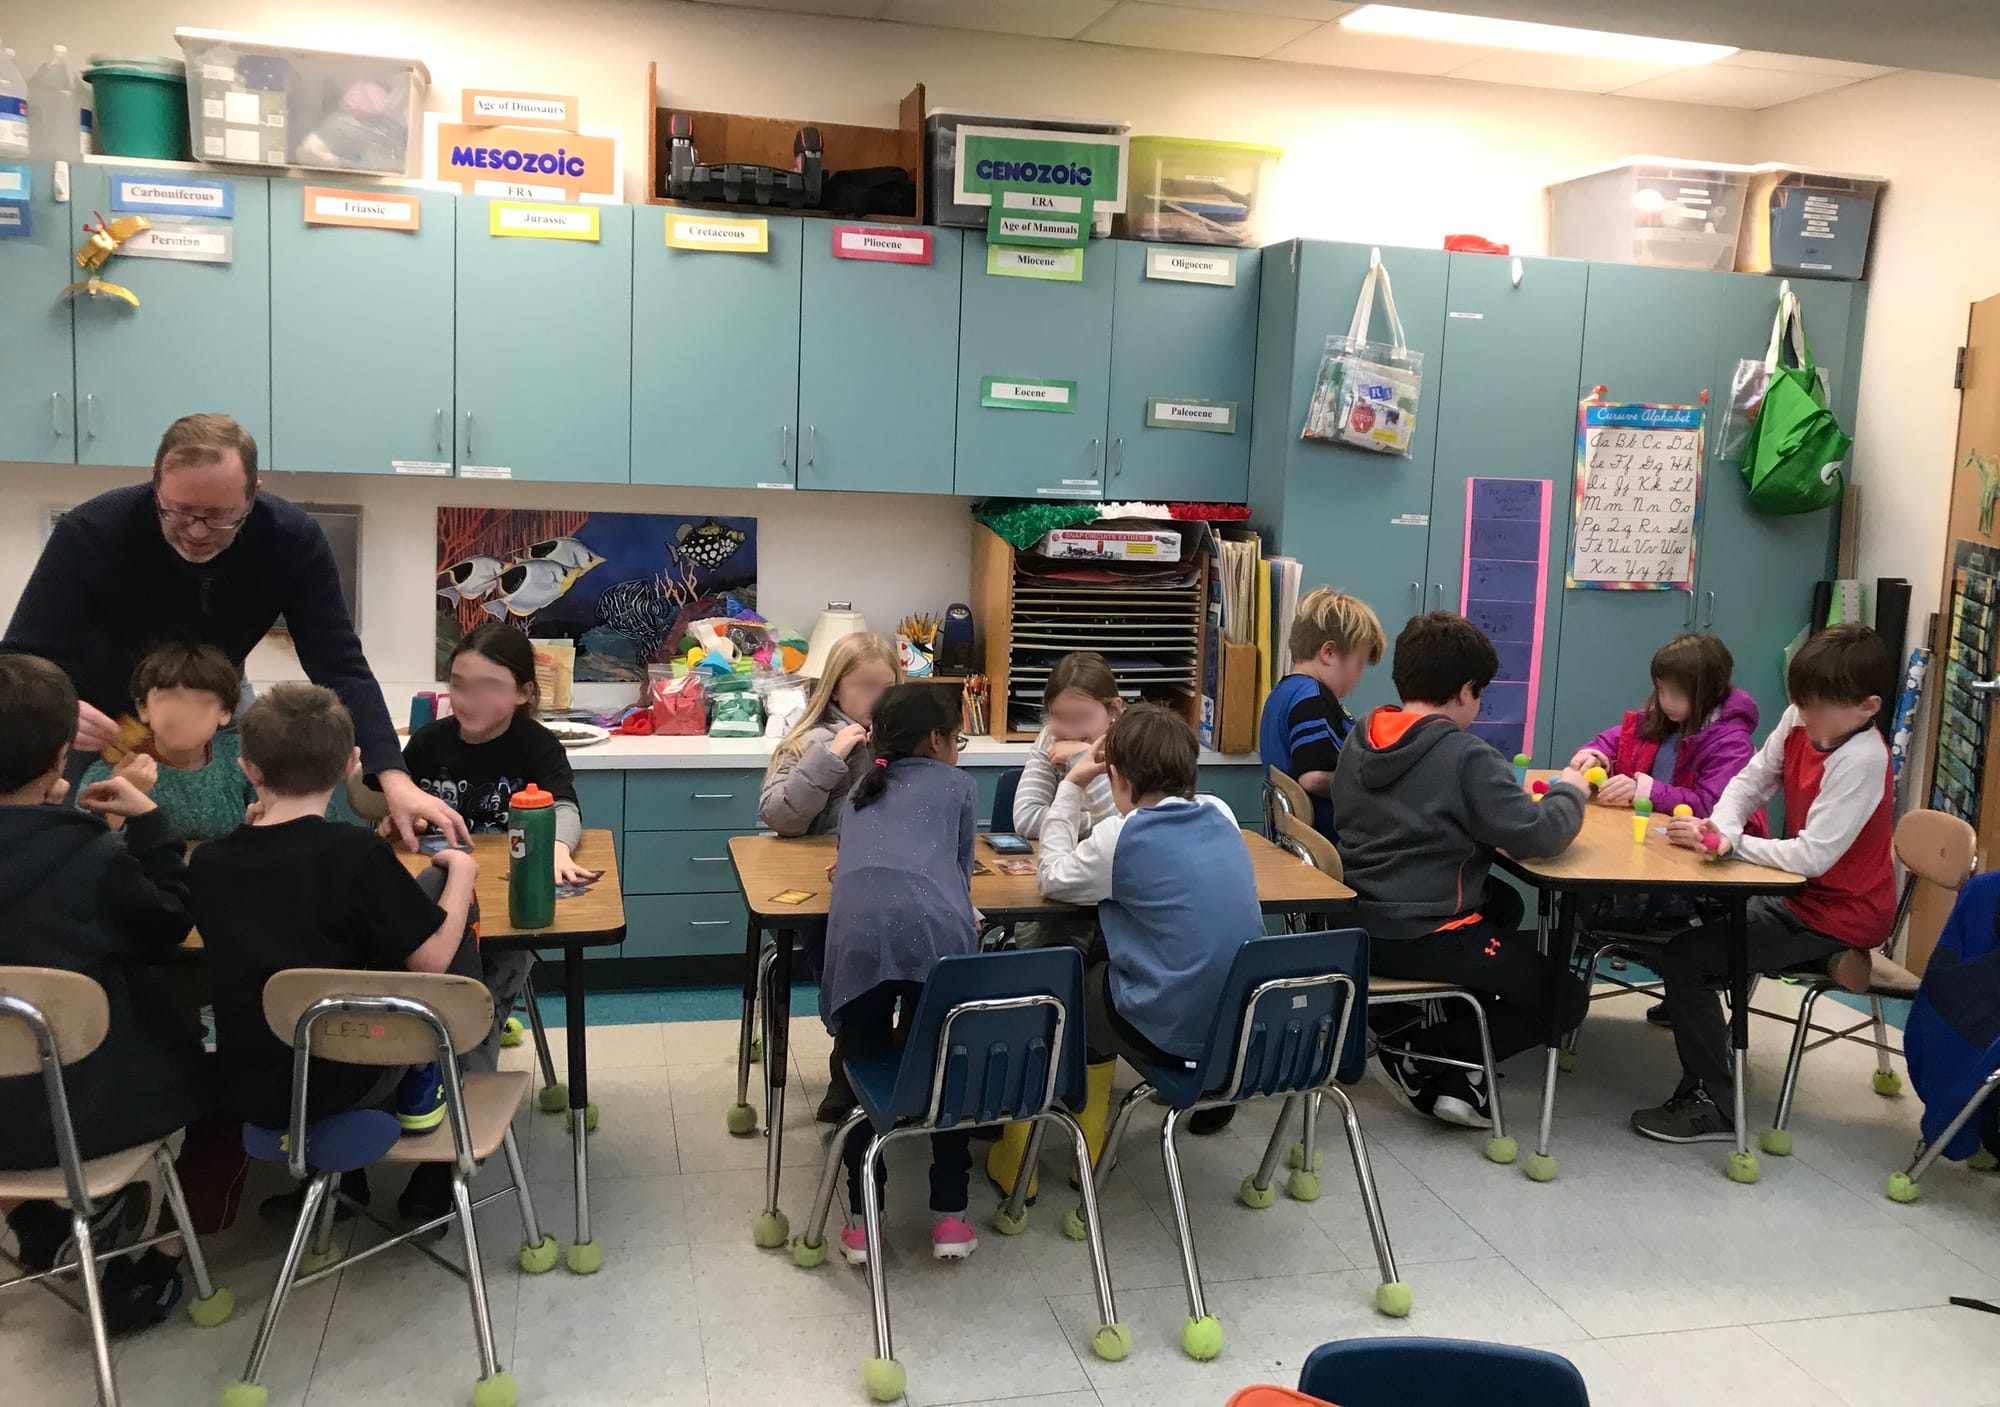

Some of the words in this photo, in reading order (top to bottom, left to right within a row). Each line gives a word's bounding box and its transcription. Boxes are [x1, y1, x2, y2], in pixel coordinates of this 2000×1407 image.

[477, 100, 496, 111] Age
[498, 101, 508, 111] of
[512, 102, 564, 114] Dinosaurs
[131, 186, 215, 202] Carboniferous
[508, 186, 534, 198] ERA
[344, 202, 386, 215] Triassic
[1031, 196, 1055, 208] ERA
[524, 213, 568, 226] Jurassic
[689, 225, 745, 239] Cretaceous
[1001, 220, 1020, 233] Age
[1021, 221, 1031, 232] of
[1033, 222, 1078, 235] Mammals
[151, 234, 201, 247] Permian
[863, 237, 903, 250] Pliocene
[1017, 254, 1056, 267] Miocene
[1171, 258, 1214, 270] Oligocene
[1014, 386, 1046, 398] Eocene
[1171, 406, 1213, 418] Paleocene
[1597, 407, 1639, 421] Cursive
[1641, 409, 1692, 426] Alphabet
